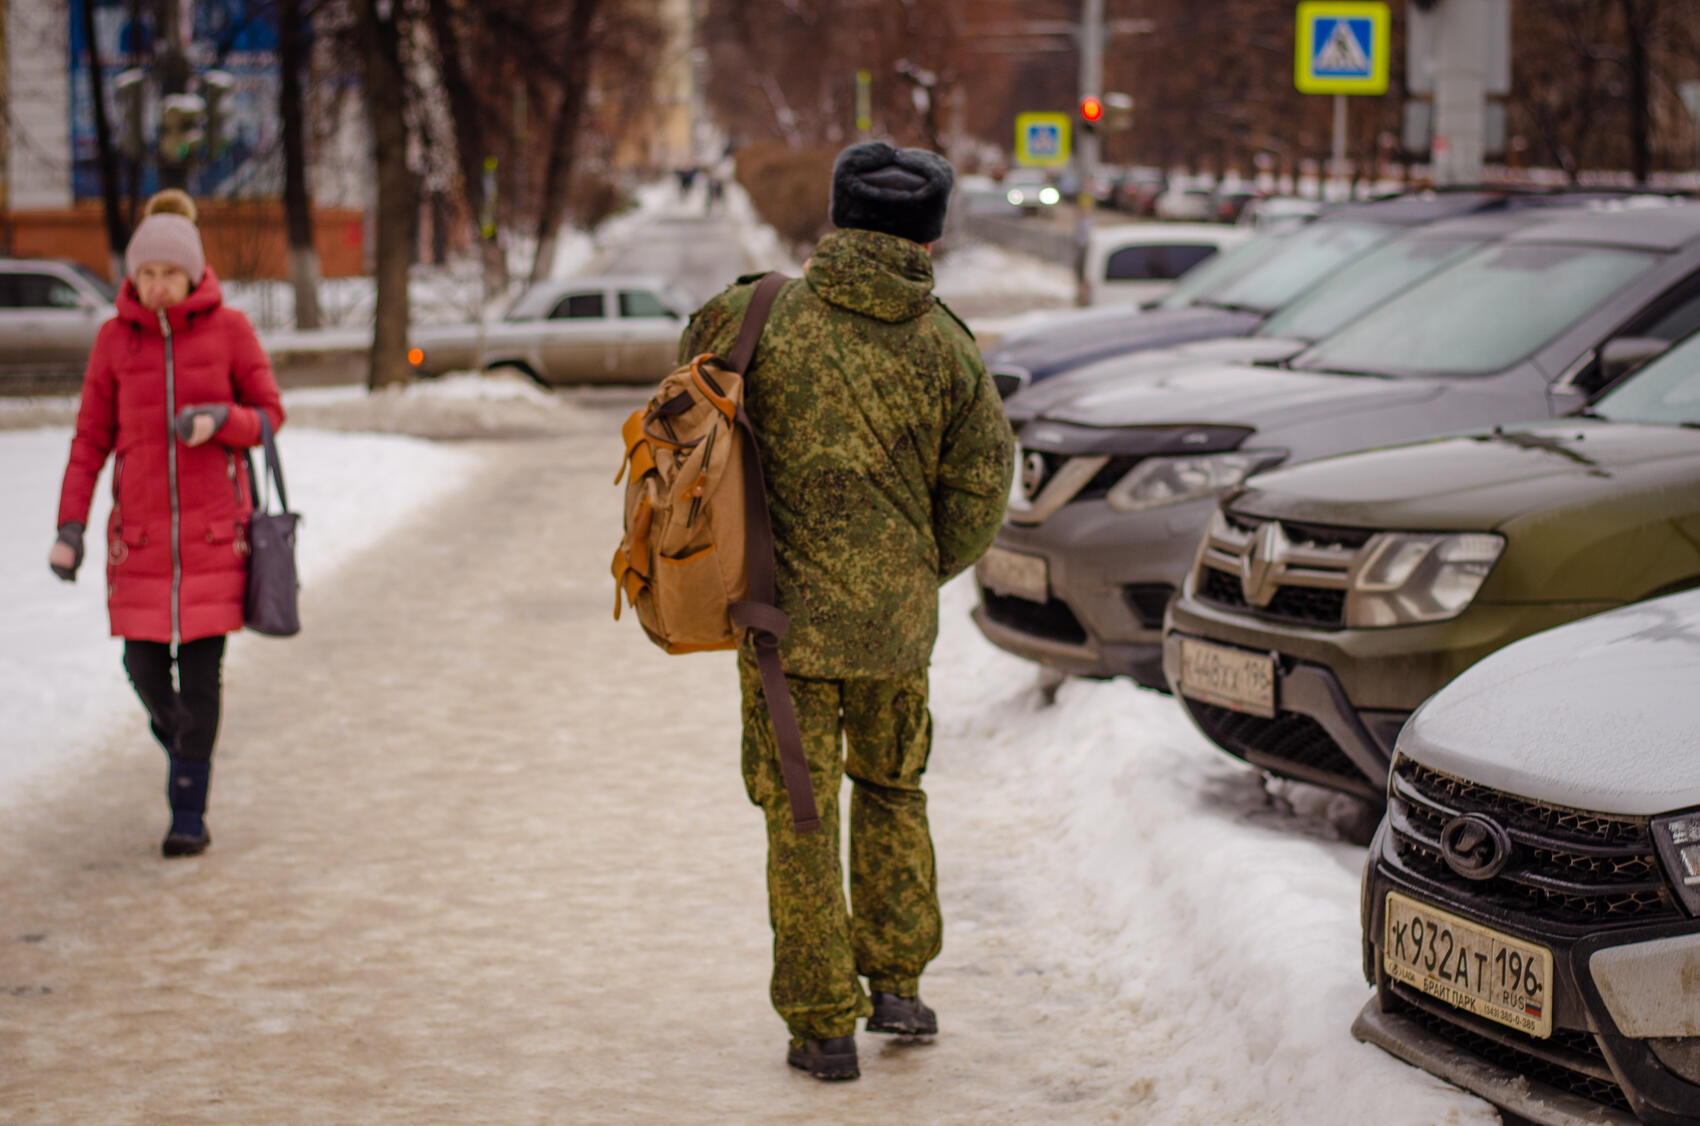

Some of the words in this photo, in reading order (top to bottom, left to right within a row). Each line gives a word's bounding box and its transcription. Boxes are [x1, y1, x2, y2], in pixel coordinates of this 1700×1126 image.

[1394, 917, 1487, 993] К932АТ
[1496, 947, 1537, 996] 196
[1453, 991, 1476, 1012] ПАРК
[1503, 990, 1525, 1010] RUS
